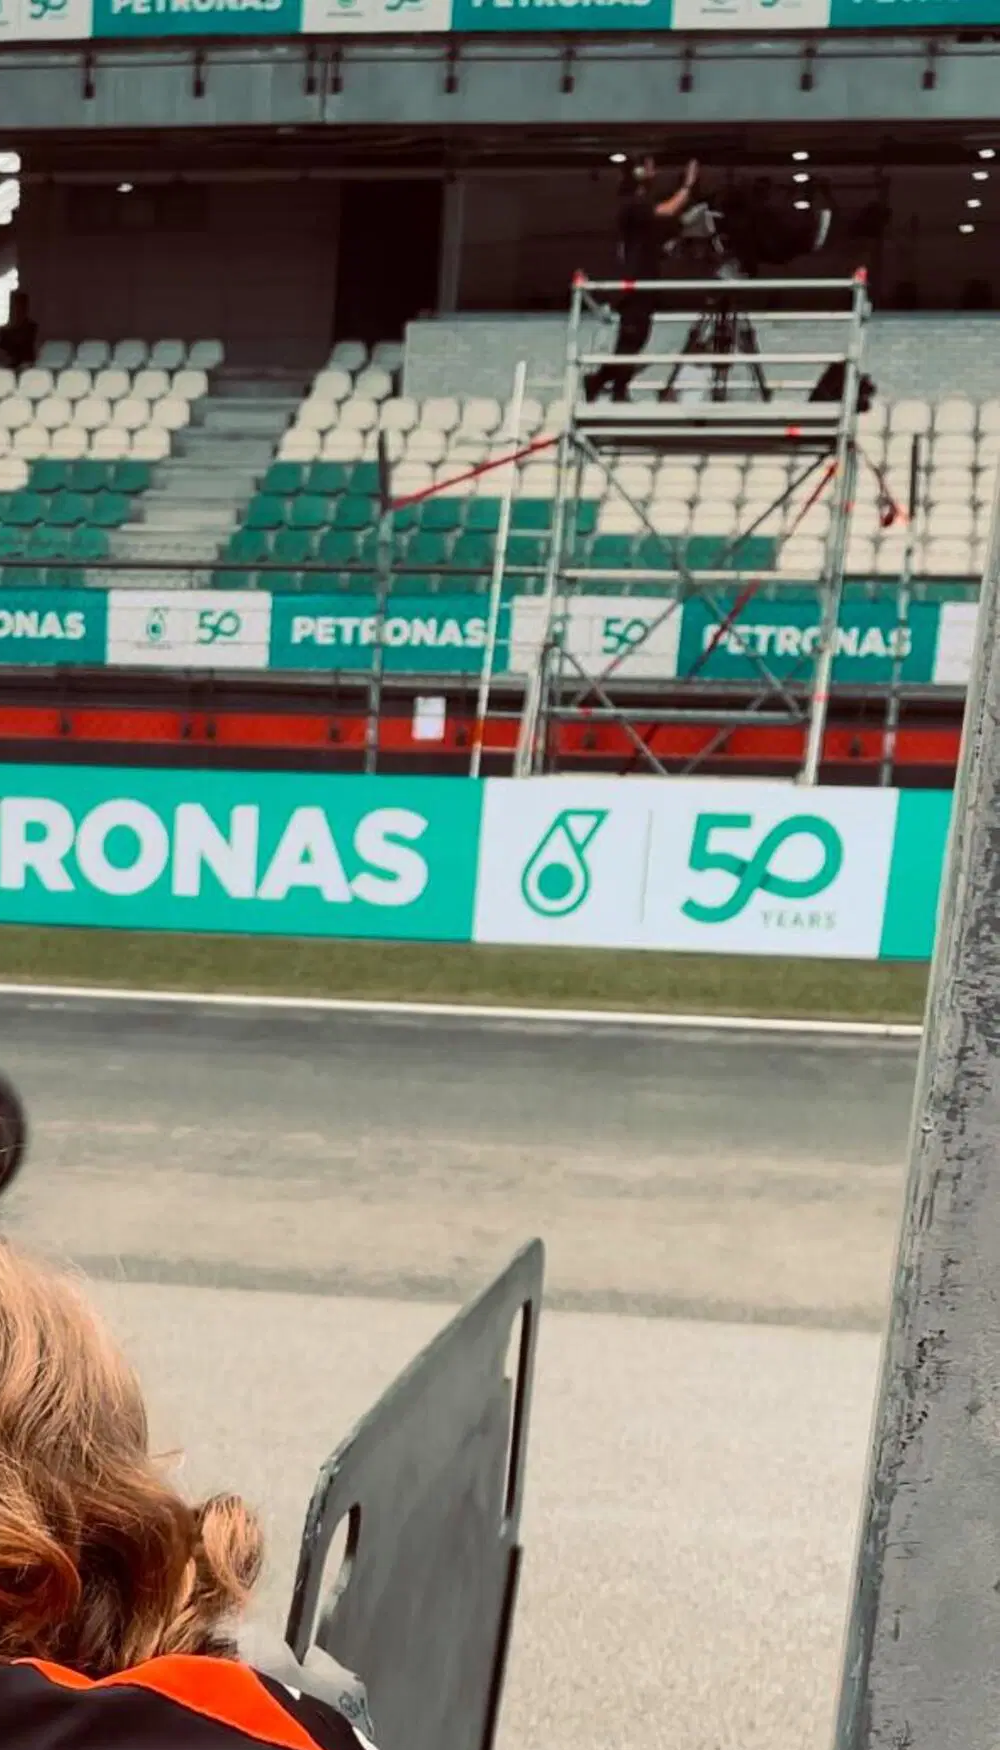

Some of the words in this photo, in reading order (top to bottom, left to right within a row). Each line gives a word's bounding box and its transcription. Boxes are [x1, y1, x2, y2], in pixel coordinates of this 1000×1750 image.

[197, 609, 241, 645] 50
[291, 616, 486, 647] PETRONAS
[680, 812, 843, 924] 50
[761, 910, 837, 931] YEARS
